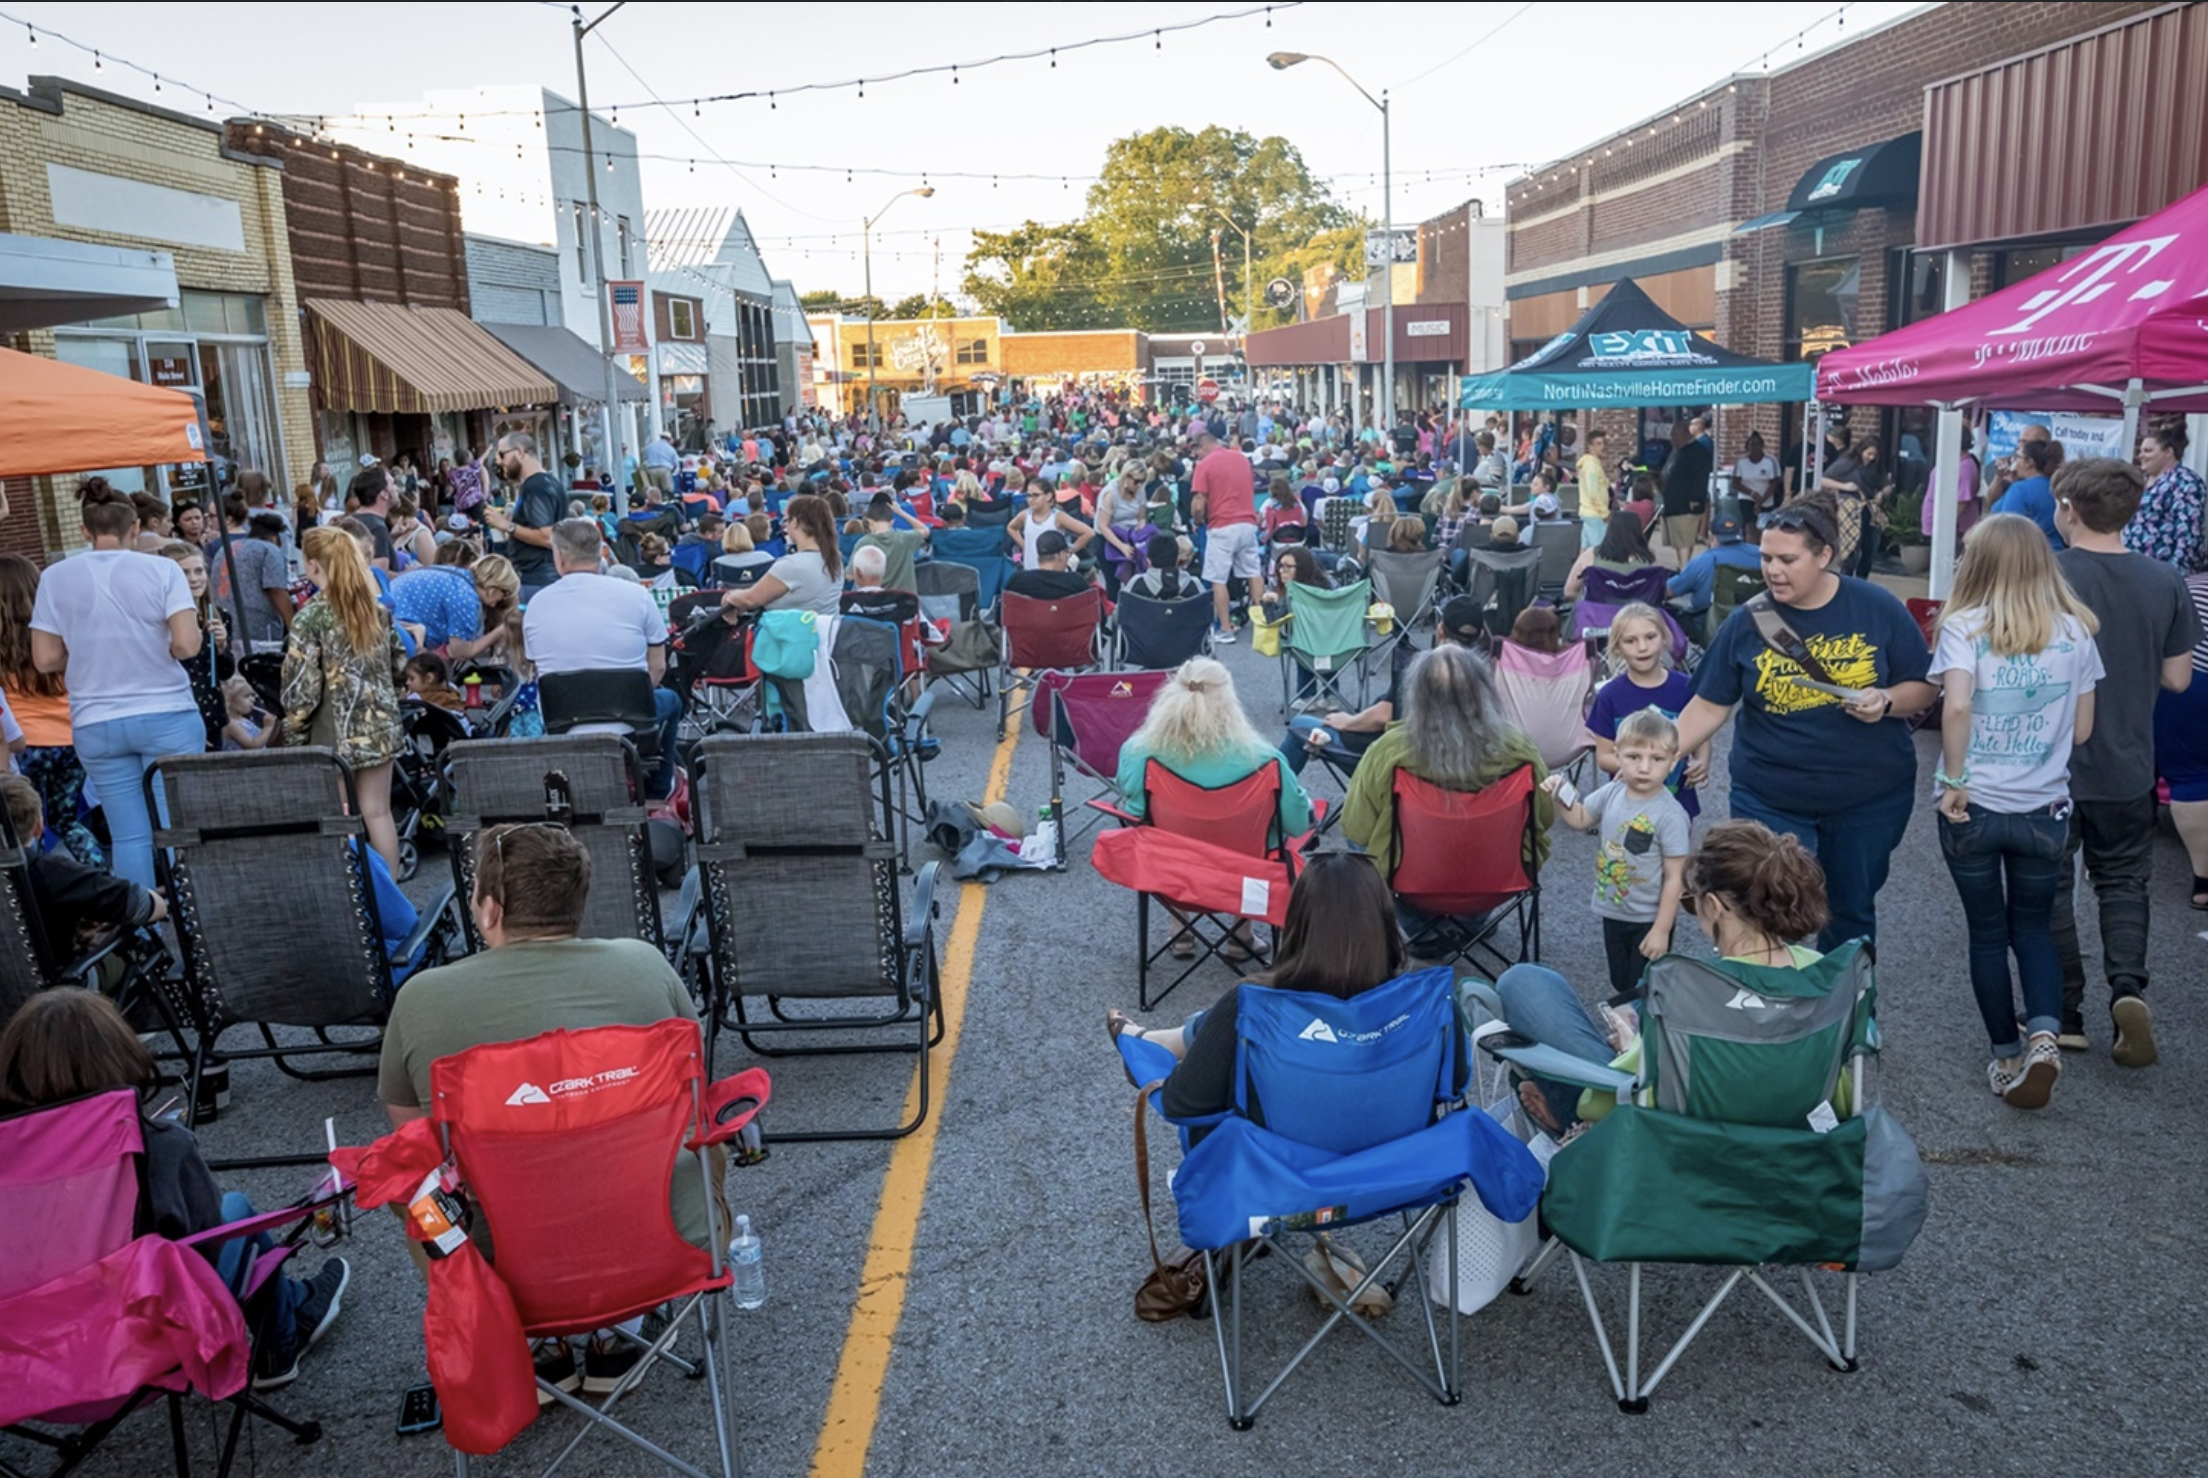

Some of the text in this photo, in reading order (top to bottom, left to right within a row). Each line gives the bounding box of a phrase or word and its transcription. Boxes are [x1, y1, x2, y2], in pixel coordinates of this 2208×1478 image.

[1411, 322, 1447, 334] MUSIC
[1199, 386, 1219, 396] STOP
[1543, 378, 1776, 400] NorthNashvilleHomeFinder.com
[2055, 426, 2104, 442] Call today and
[2026, 714, 2044, 732] TO
